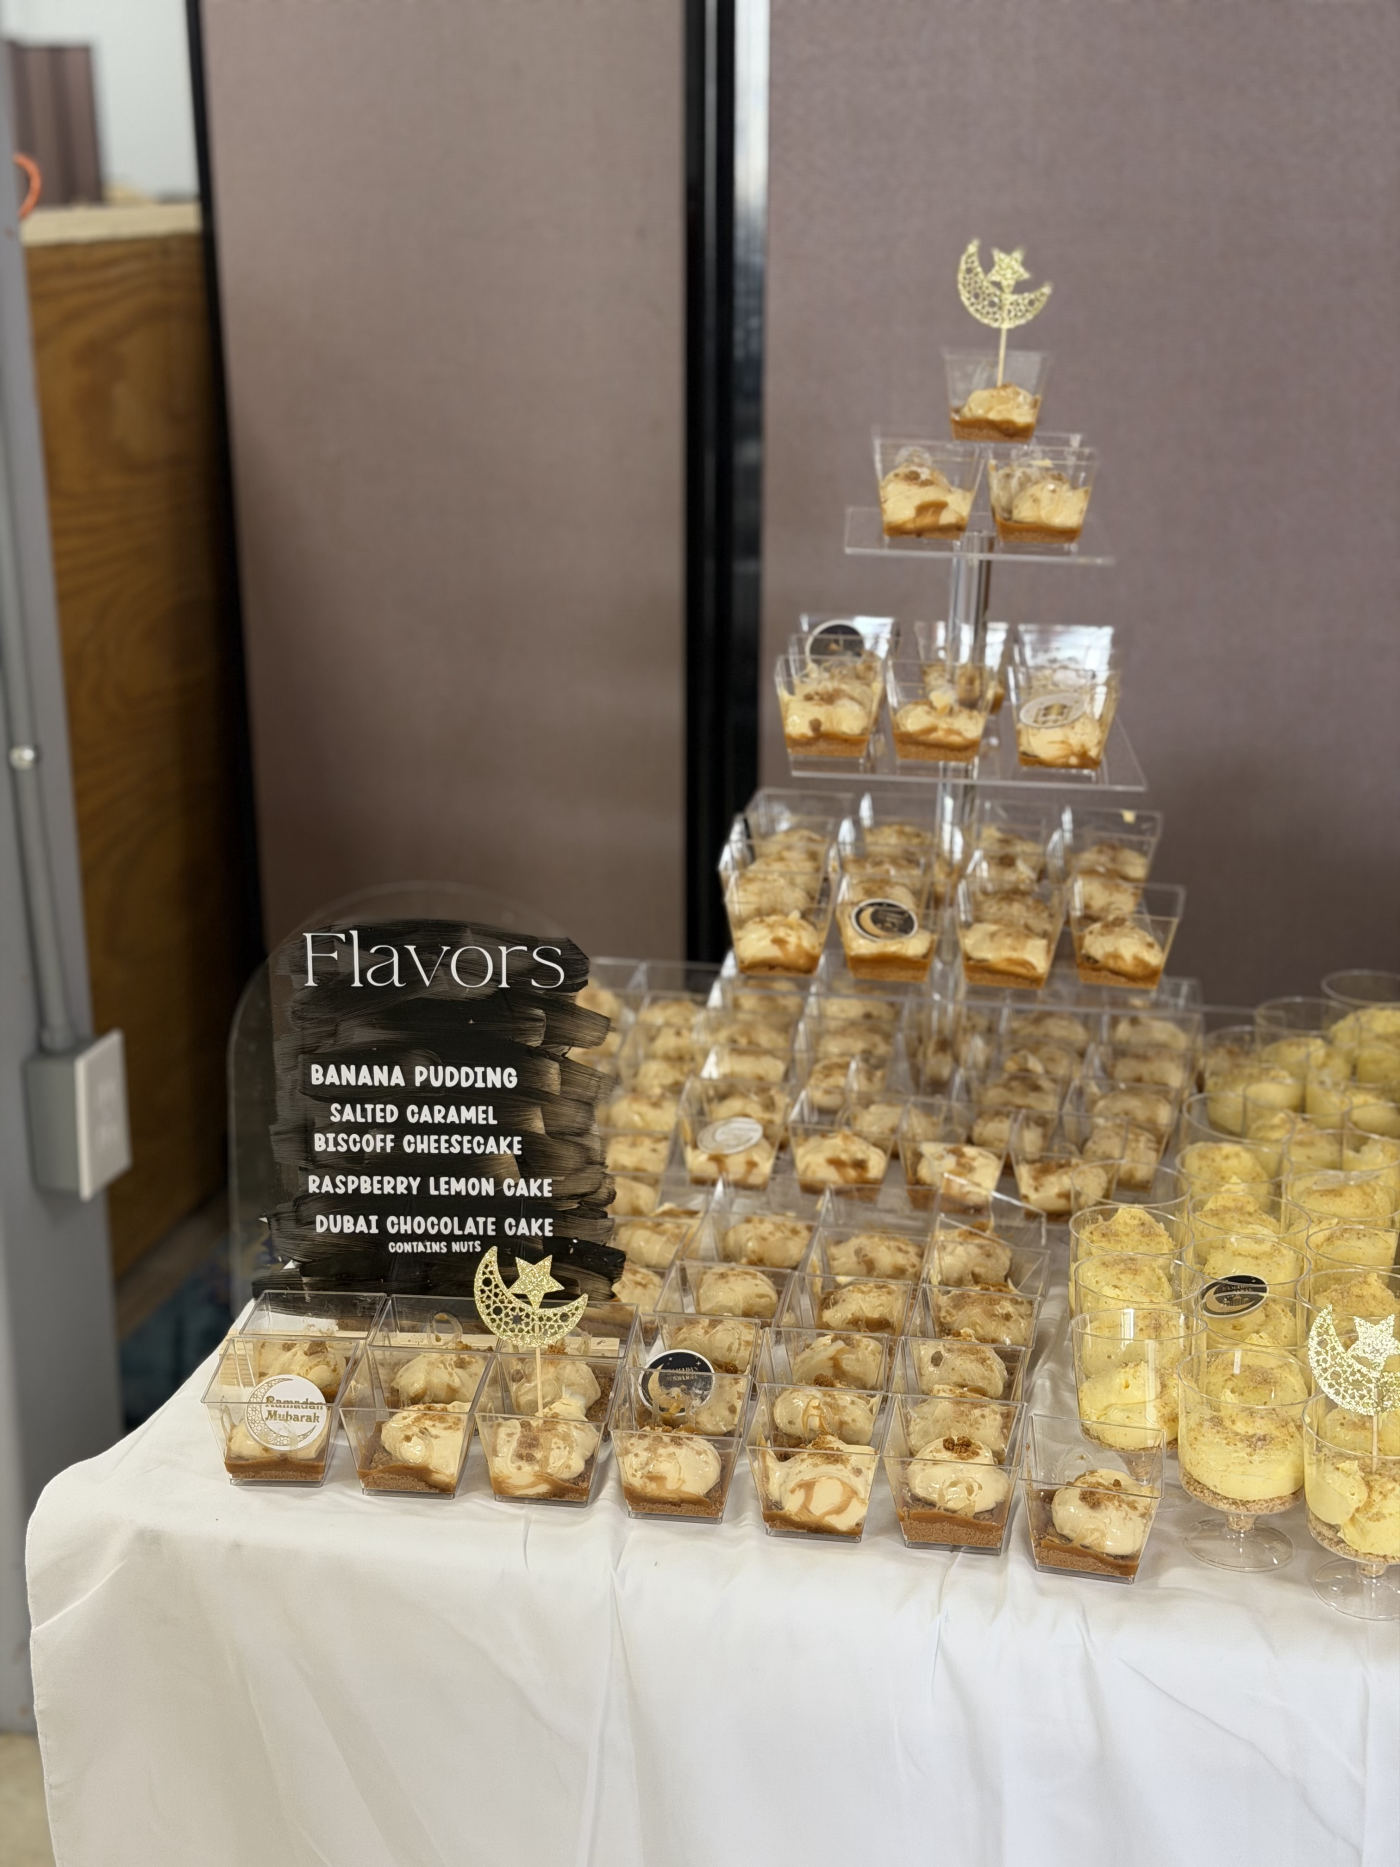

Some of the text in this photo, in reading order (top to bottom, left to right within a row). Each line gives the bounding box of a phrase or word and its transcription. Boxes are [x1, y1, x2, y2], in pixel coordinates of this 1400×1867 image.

[302, 929, 565, 988] Flavors
[311, 1064, 518, 1088] BANANA PUDDING
[330, 1103, 498, 1125] SALTED CARAMEL
[314, 1133, 522, 1155] BISCOFF CHEESECAKE
[308, 1175, 553, 1197] RASPBERRY LEMON CAKE
[316, 1214, 554, 1237] DUBAI CHOCOLATE CAKE
[388, 1240, 481, 1254] CONTAINS NUTS
[265, 1396, 324, 1410] Ramadan
[265, 1410, 320, 1423] Mubarak
